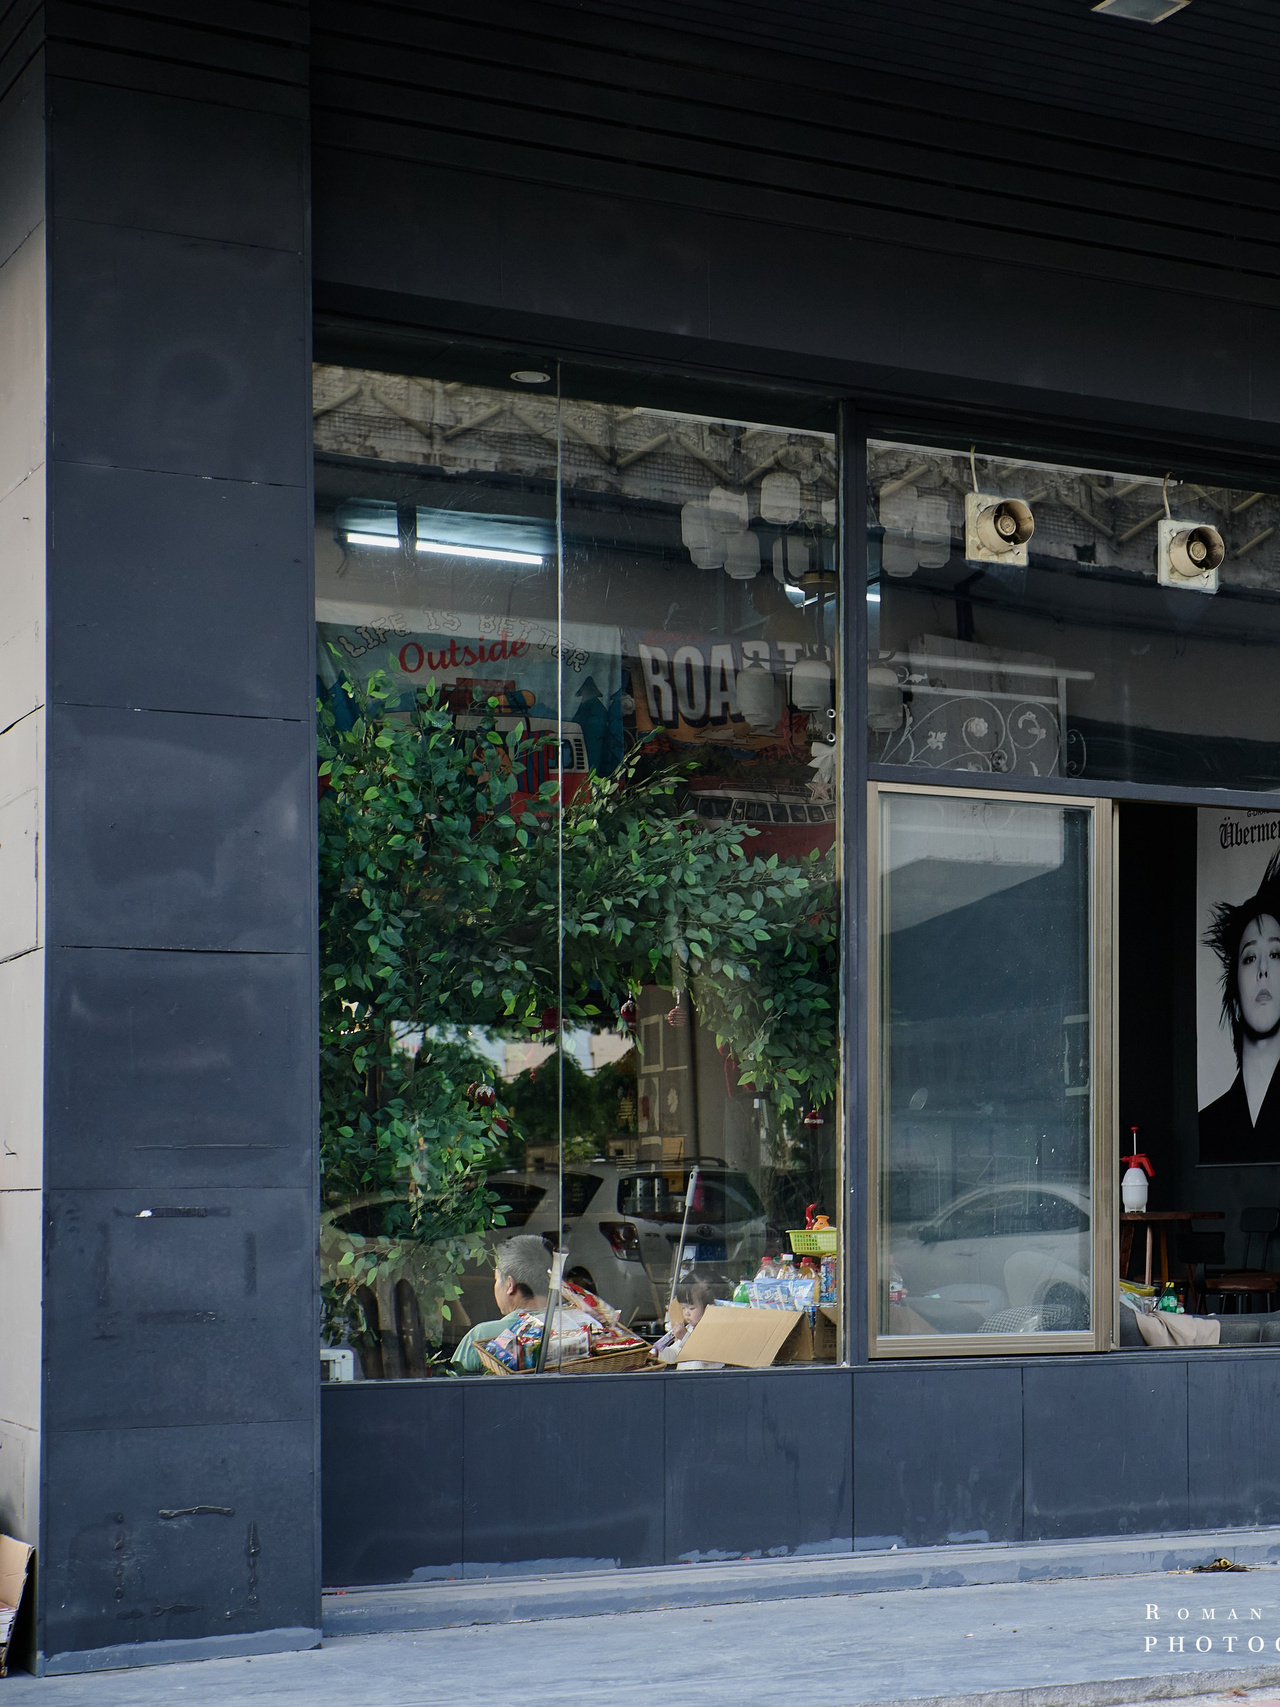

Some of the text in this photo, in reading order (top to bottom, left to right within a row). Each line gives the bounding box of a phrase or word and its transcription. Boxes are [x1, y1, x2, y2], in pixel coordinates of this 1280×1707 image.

[337, 608, 591, 673] LIFE IS BETTER
[399, 630, 533, 674] Outside
